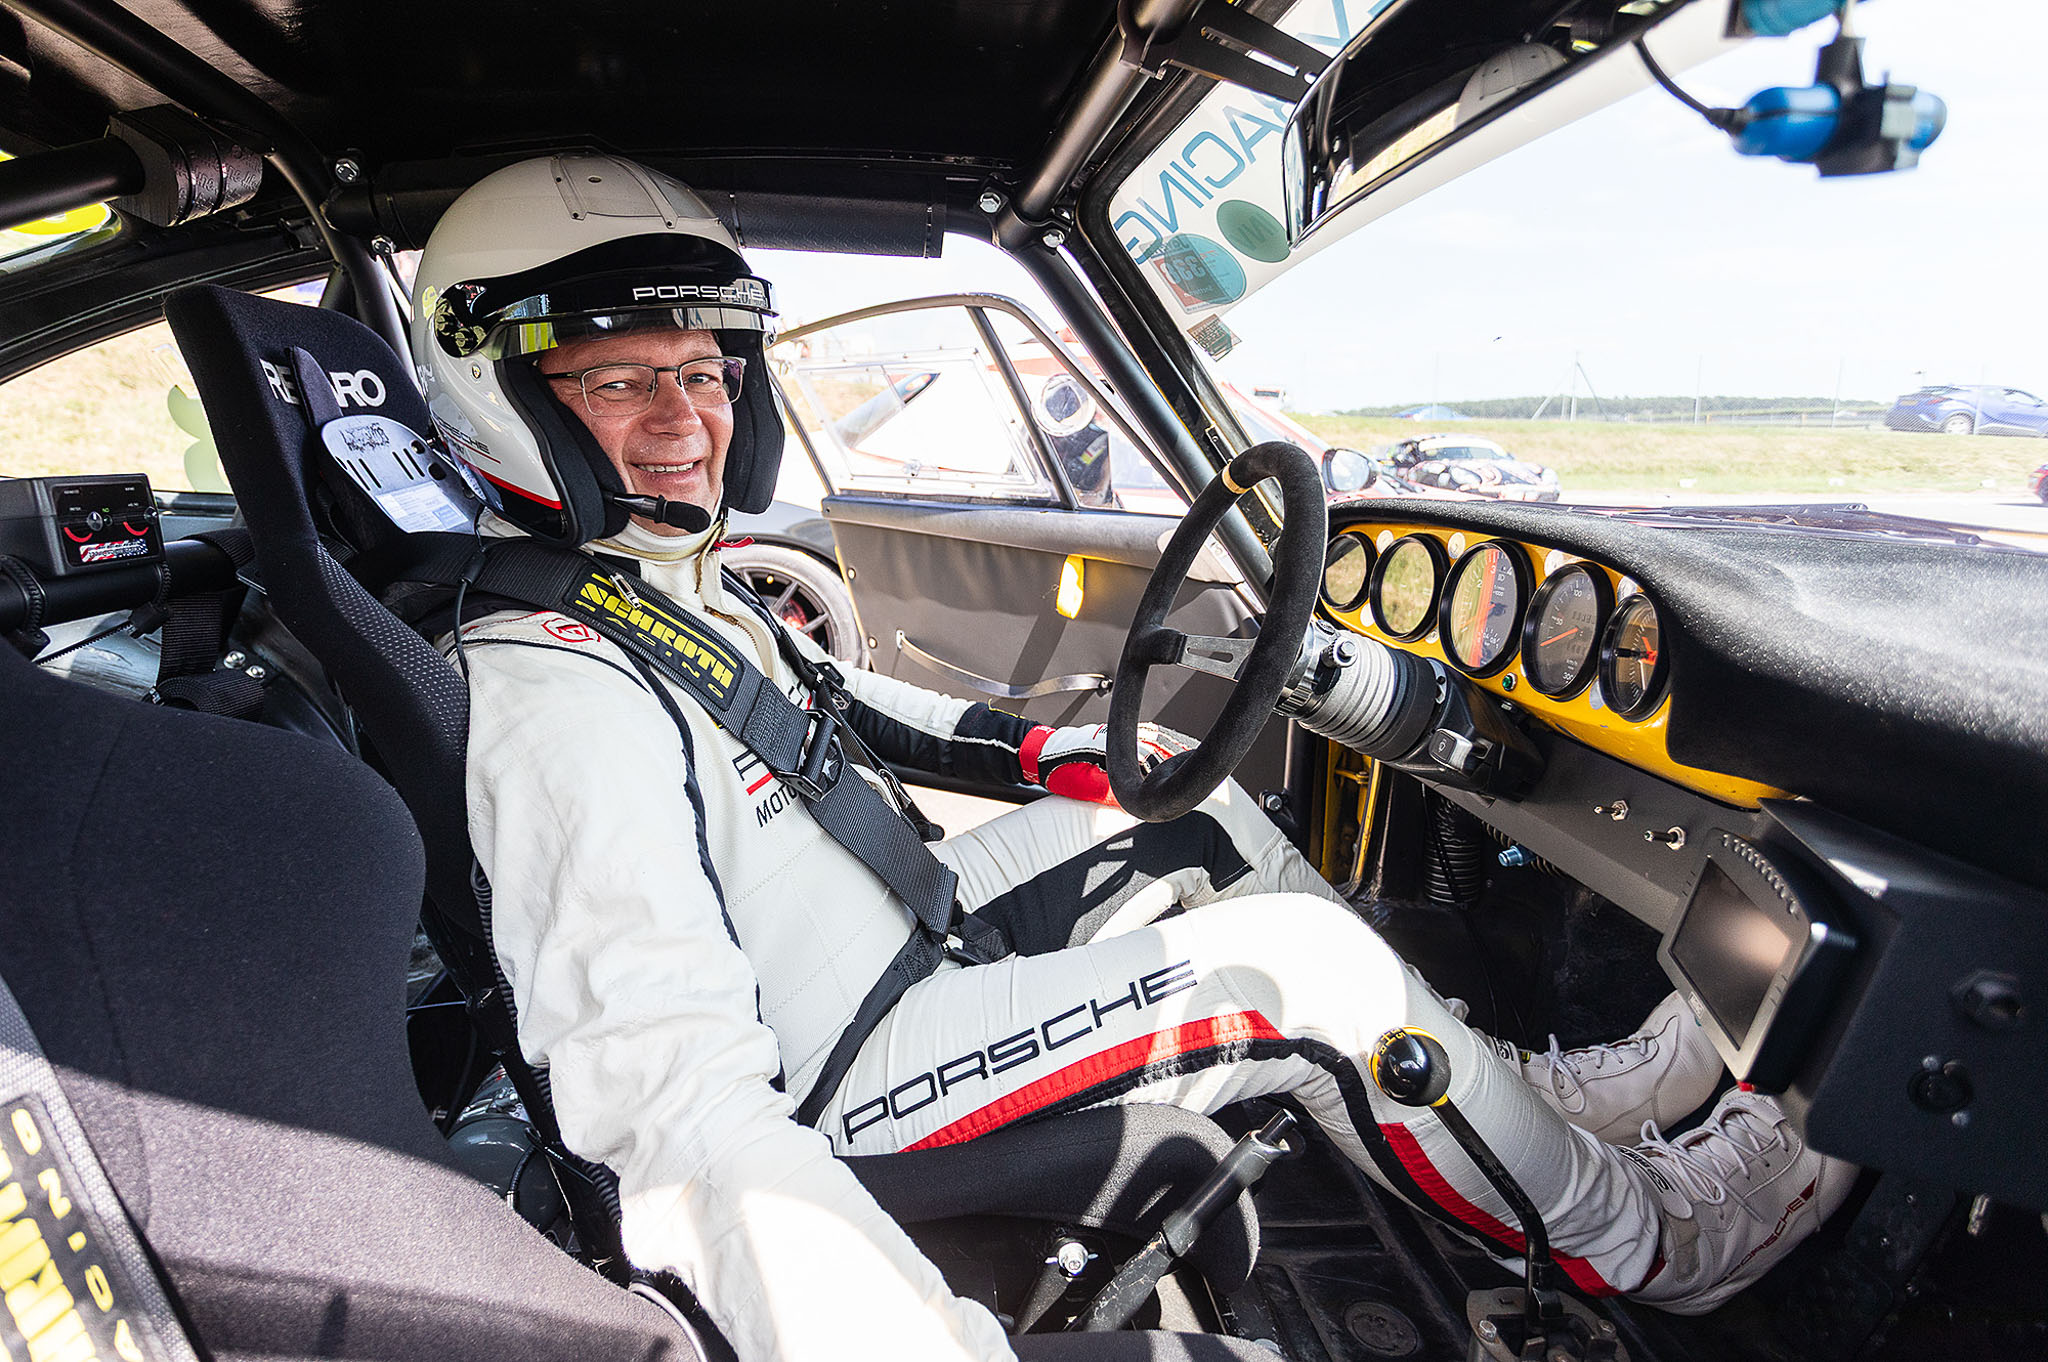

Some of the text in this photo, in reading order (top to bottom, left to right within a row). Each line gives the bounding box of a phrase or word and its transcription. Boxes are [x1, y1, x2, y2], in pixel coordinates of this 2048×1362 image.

[632, 285, 763, 301] PORSCHE
[259, 358, 386, 408] RERO
[580, 582, 734, 689] SCHROTH
[842, 959, 1198, 1146] PORSCHE
